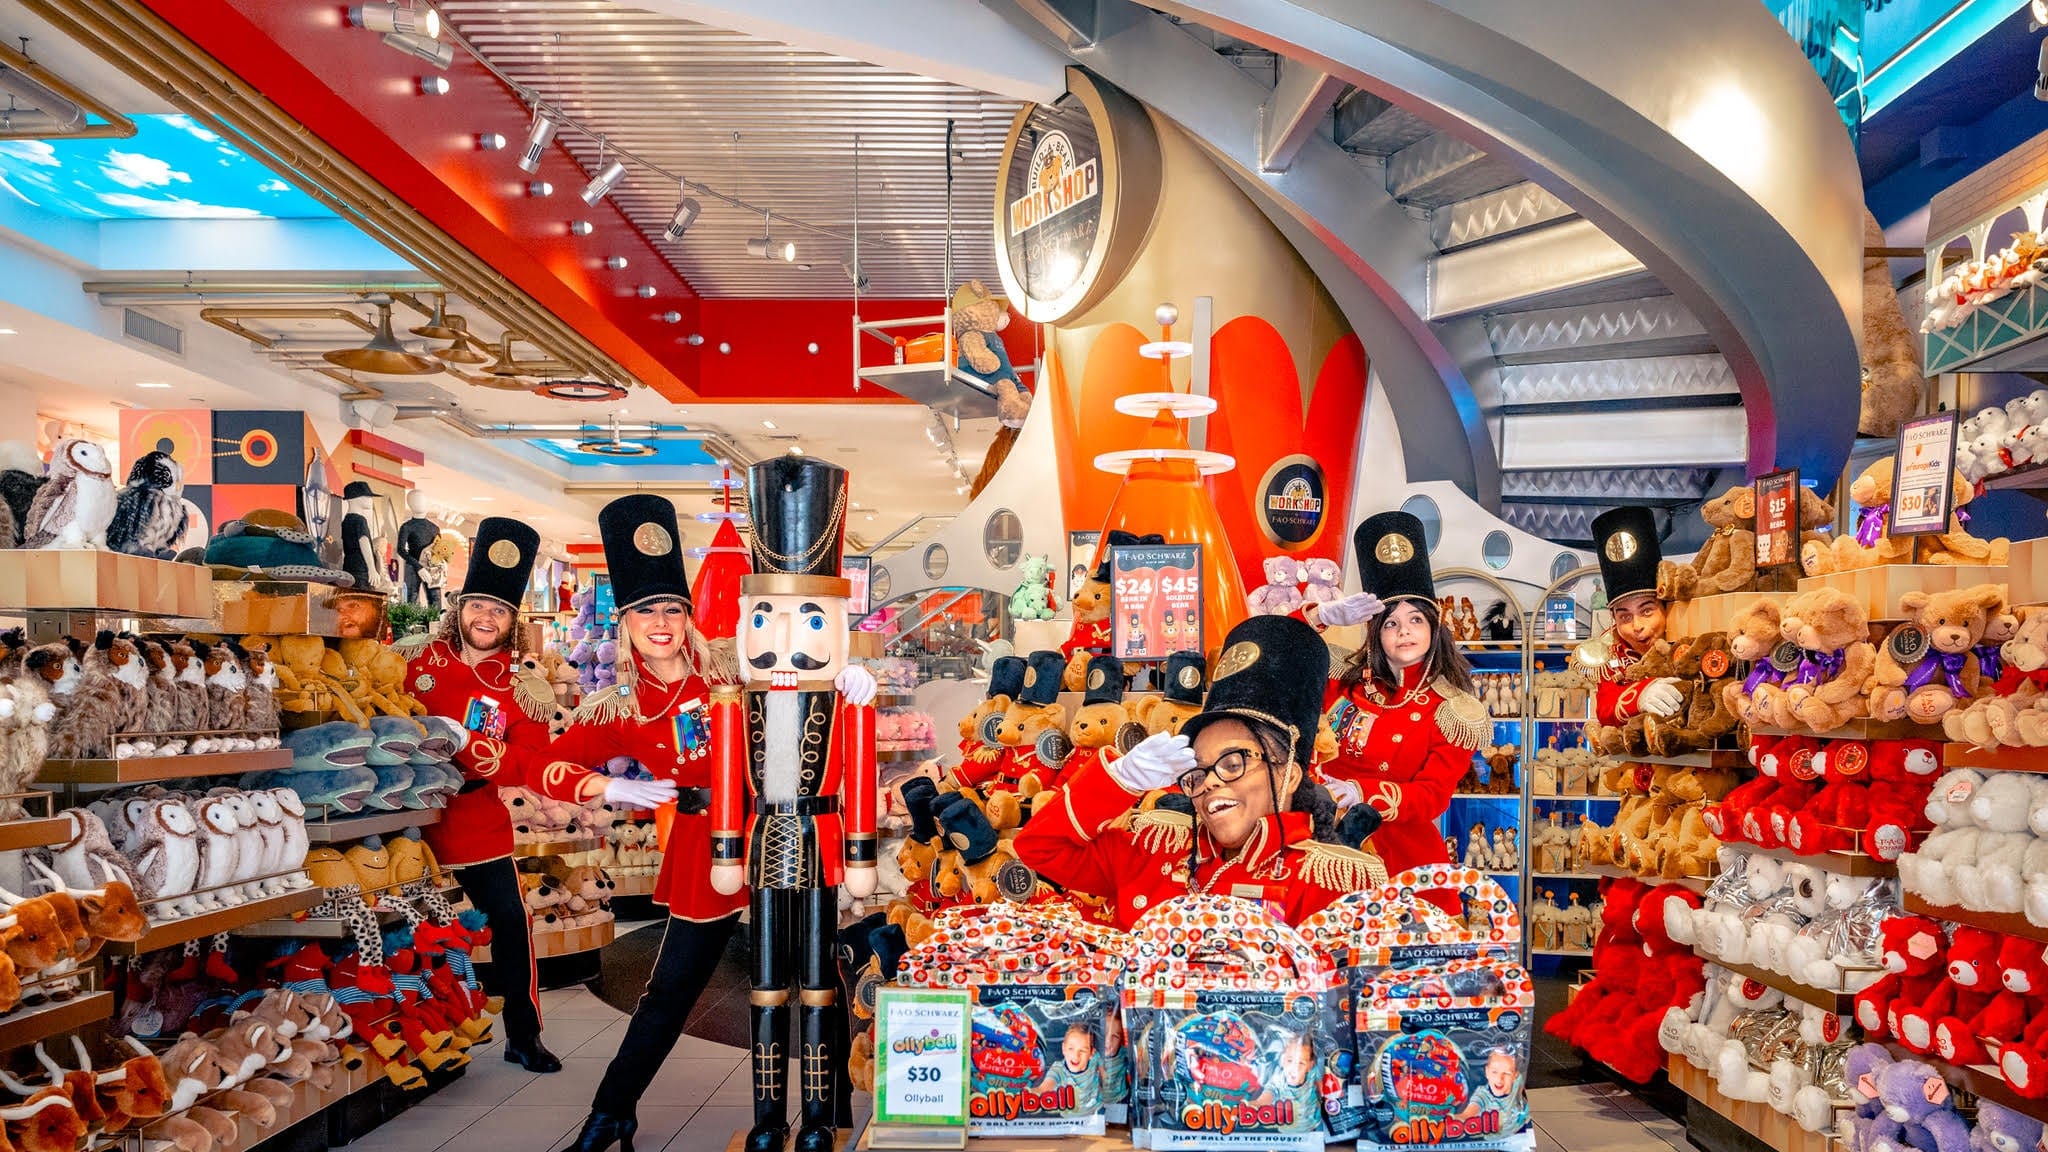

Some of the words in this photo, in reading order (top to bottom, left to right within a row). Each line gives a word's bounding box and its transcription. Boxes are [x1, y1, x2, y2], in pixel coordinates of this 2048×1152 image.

[1012, 163, 1095, 233] WORKSHOP
[1270, 496, 1320, 511] WORKSHOP
[1769, 497, 1786, 513] $15
[1902, 495, 1921, 511] $30
[1146, 552, 1187, 561] SCHWARZ
[1116, 577, 1153, 595] $24
[1161, 576, 1199, 594] $45
[1423, 948, 1469, 957] SCHWARZ
[1012, 987, 1058, 996] SCHWARZ
[1230, 994, 1276, 1003] SCHWARZ
[914, 1008, 960, 1017] SCHWARZ
[1434, 1012, 1480, 1022] SCHWARZ
[892, 1033, 957, 1056] ollyball
[907, 1065, 942, 1082] $30
[904, 1093, 944, 1104] Ollyball
[970, 1084, 1075, 1121] ollyball
[1184, 1100, 1293, 1135] ollyball
[1390, 1109, 1500, 1145] ollyball
